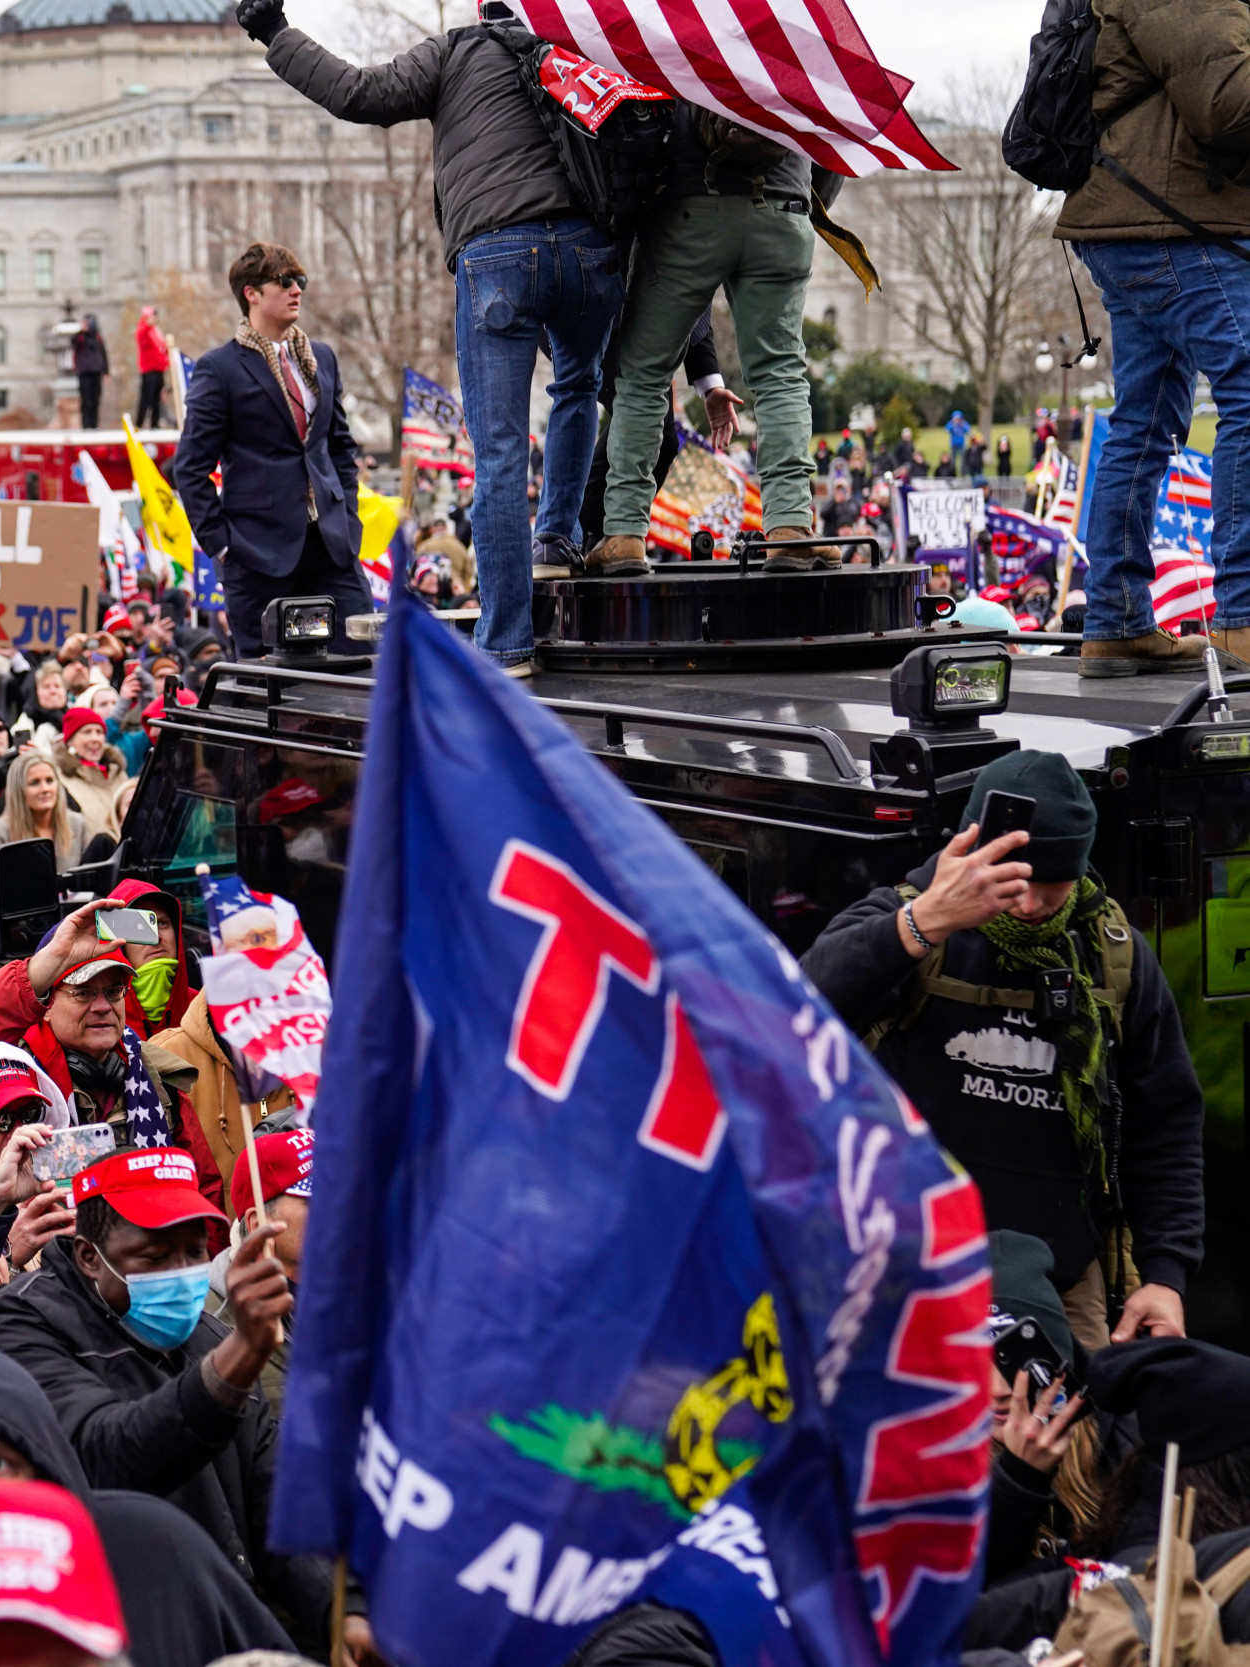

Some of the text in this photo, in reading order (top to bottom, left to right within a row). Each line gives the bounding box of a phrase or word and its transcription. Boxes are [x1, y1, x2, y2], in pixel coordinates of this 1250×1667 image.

[910, 495, 979, 515] WELCOME
[918, 514, 967, 531] TO TH
[127, 1153, 163, 1171] KEEP
